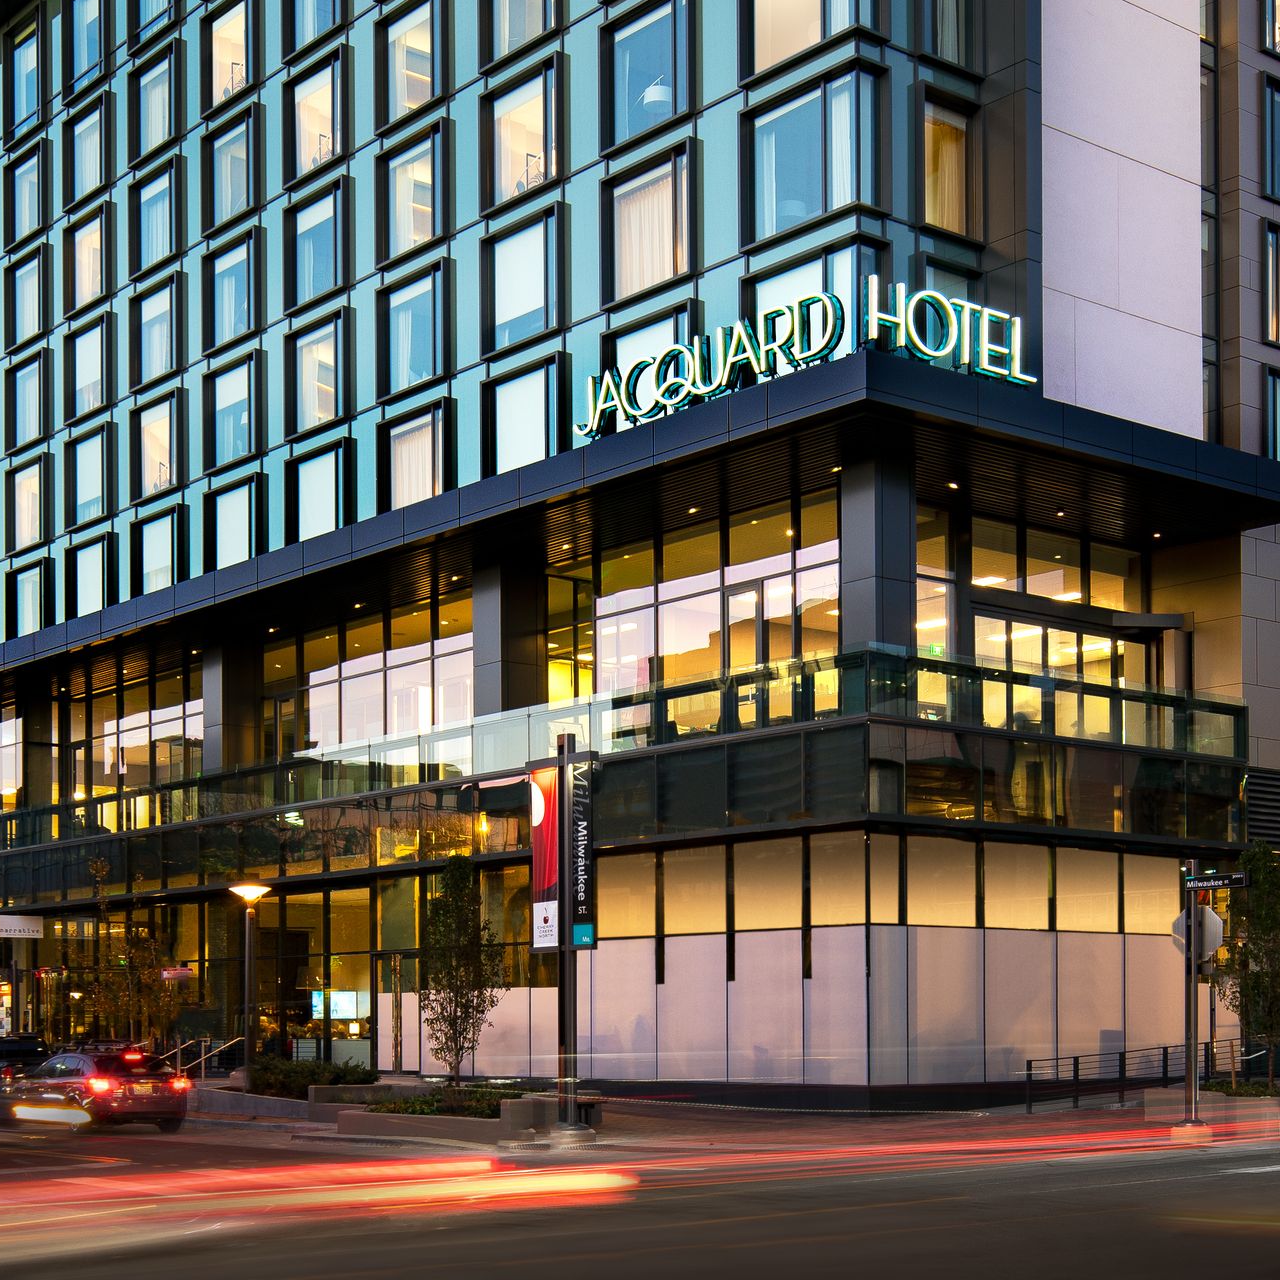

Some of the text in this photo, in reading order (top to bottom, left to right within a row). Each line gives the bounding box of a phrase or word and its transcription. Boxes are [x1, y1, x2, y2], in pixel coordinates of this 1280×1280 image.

[573, 273, 1038, 438] JACQUARD HOTEL
[577, 821, 588, 901] Milwaukee
[1186, 880, 1223, 888] Milwaukee
